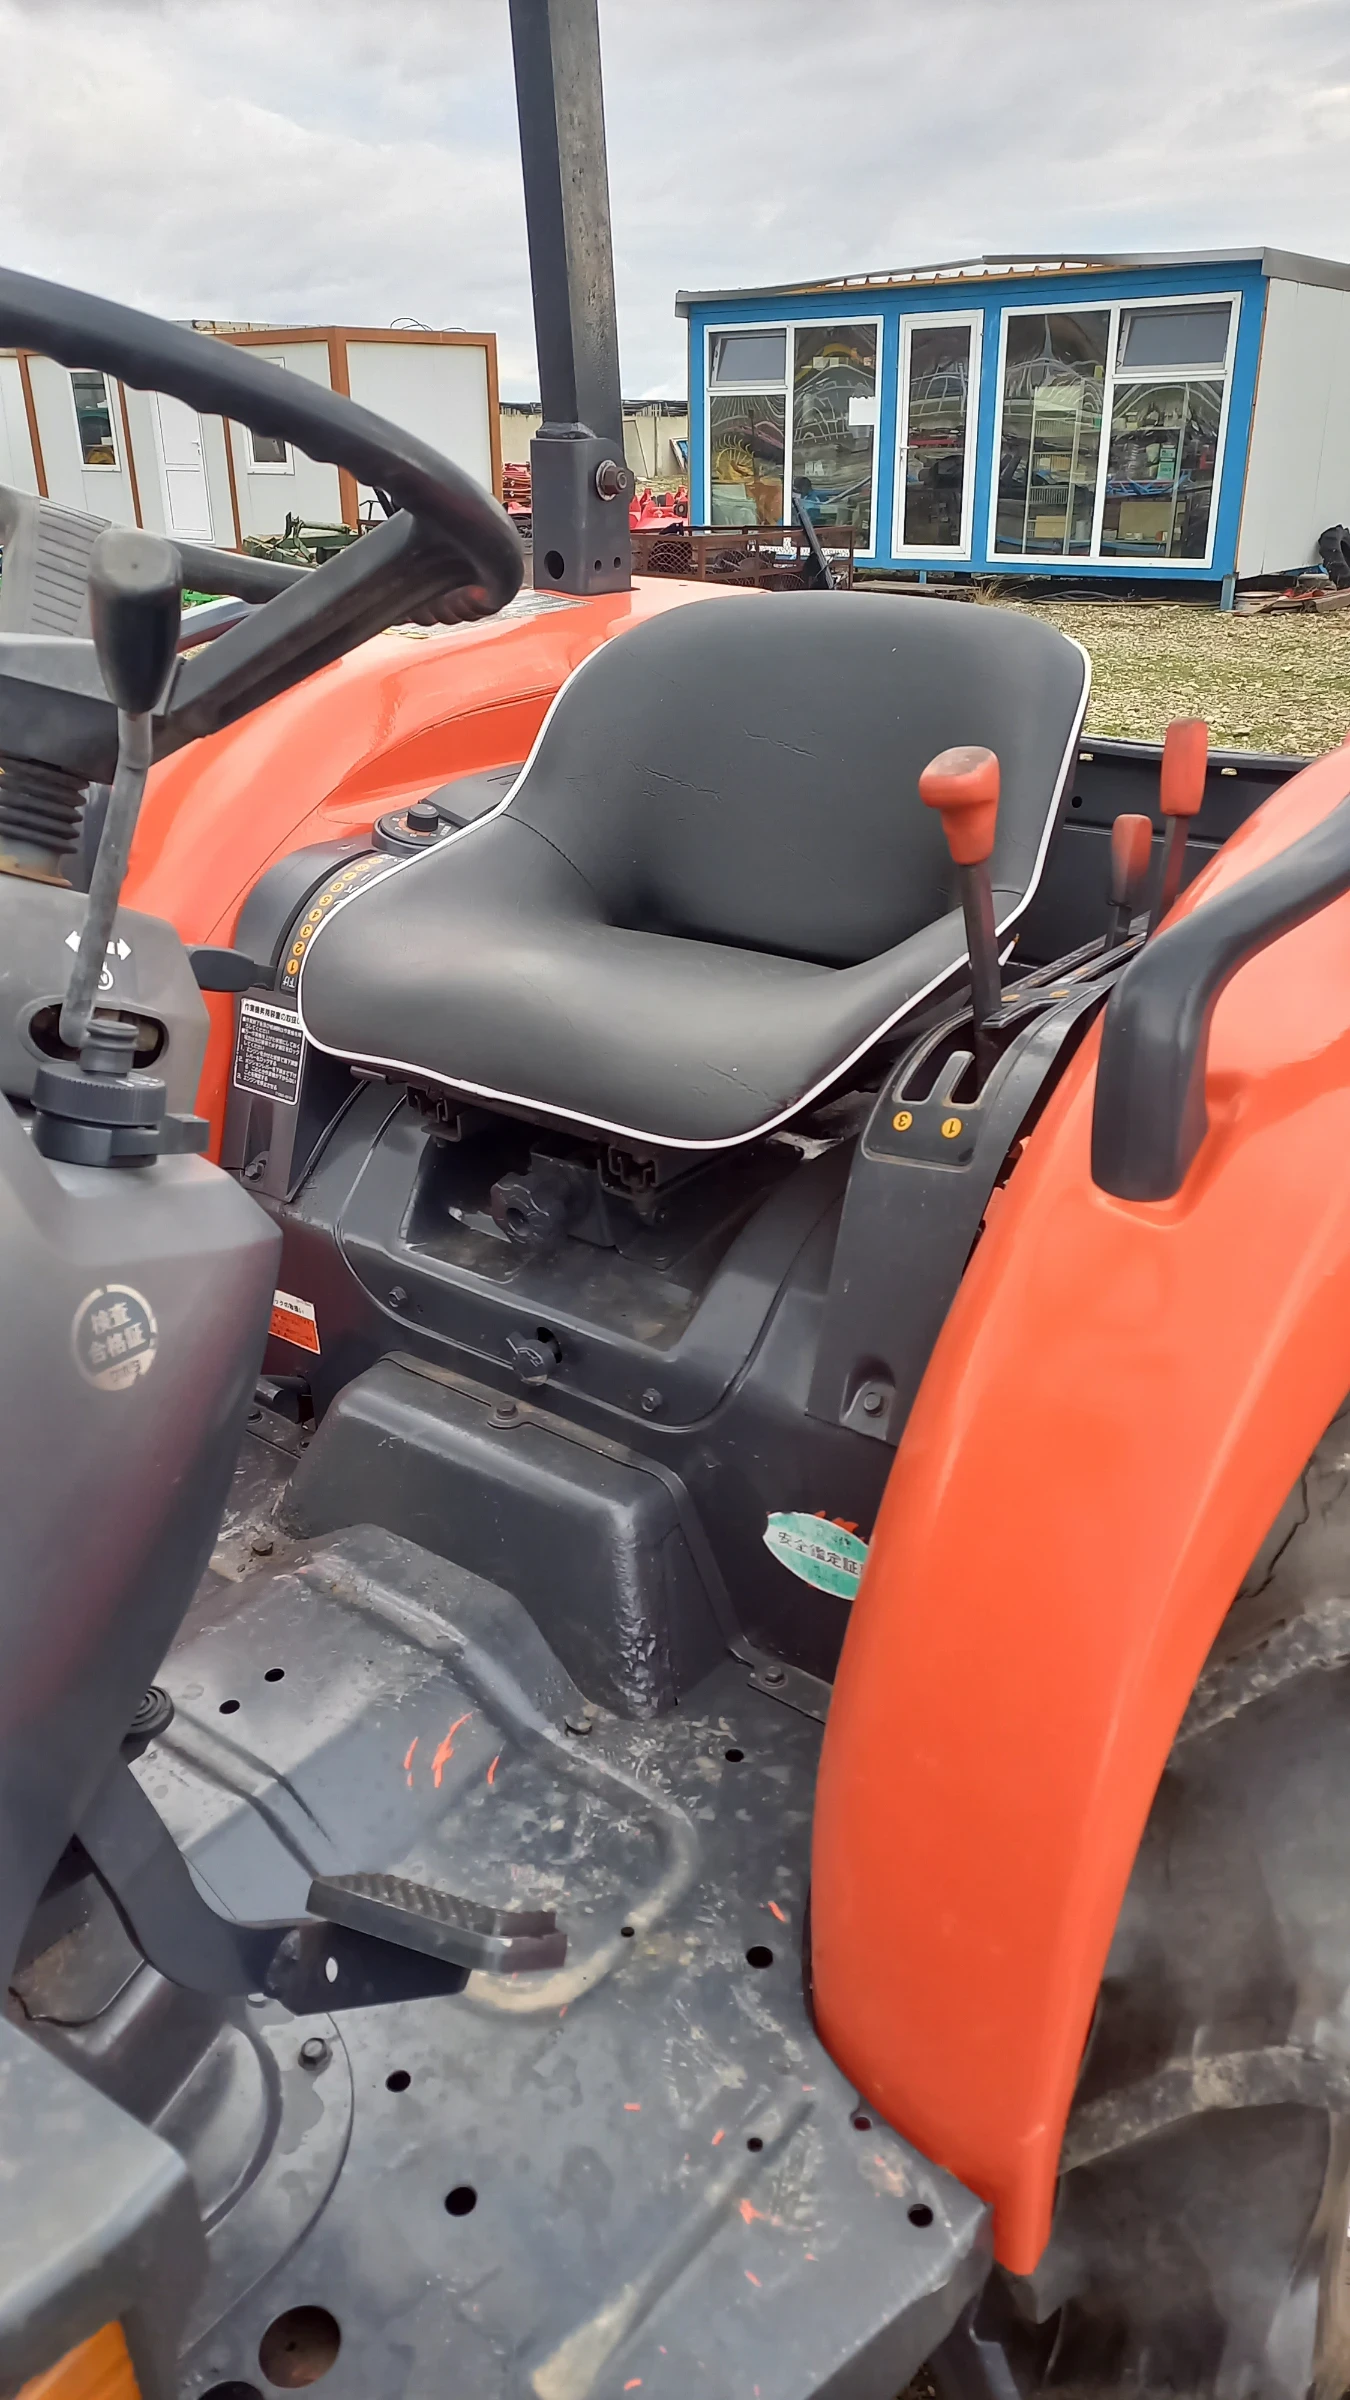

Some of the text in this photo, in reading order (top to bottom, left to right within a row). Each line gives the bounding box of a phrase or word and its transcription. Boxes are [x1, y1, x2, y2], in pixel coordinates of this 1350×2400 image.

[777, 1530, 864, 1576] 安全鑑定証
